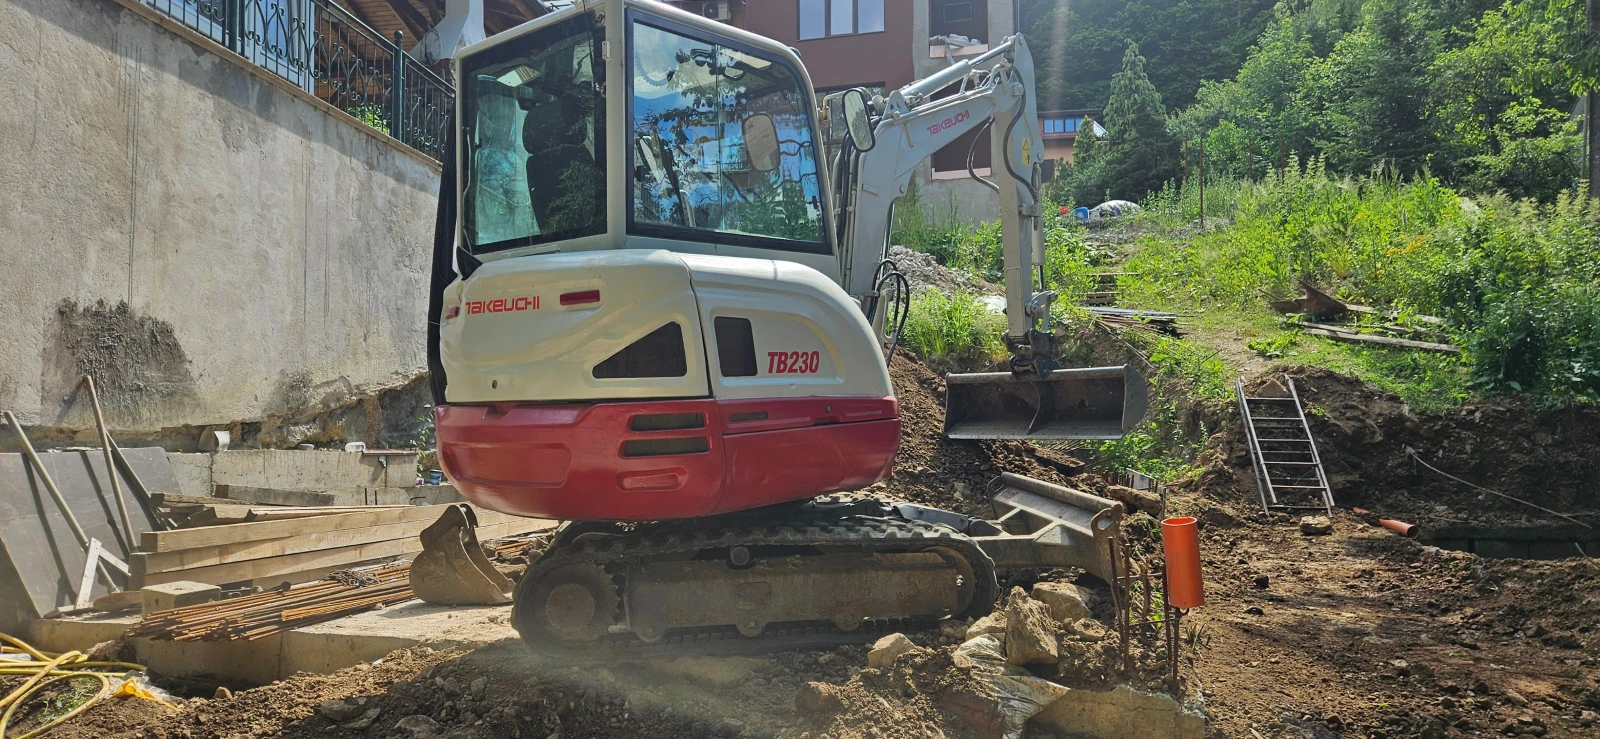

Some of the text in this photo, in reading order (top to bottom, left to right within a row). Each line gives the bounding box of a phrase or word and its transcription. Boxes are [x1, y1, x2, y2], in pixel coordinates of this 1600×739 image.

[927, 109, 970, 135] TAKEUCHI
[465, 296, 540, 315] TAKEUCHI
[767, 350, 820, 374] TB230
